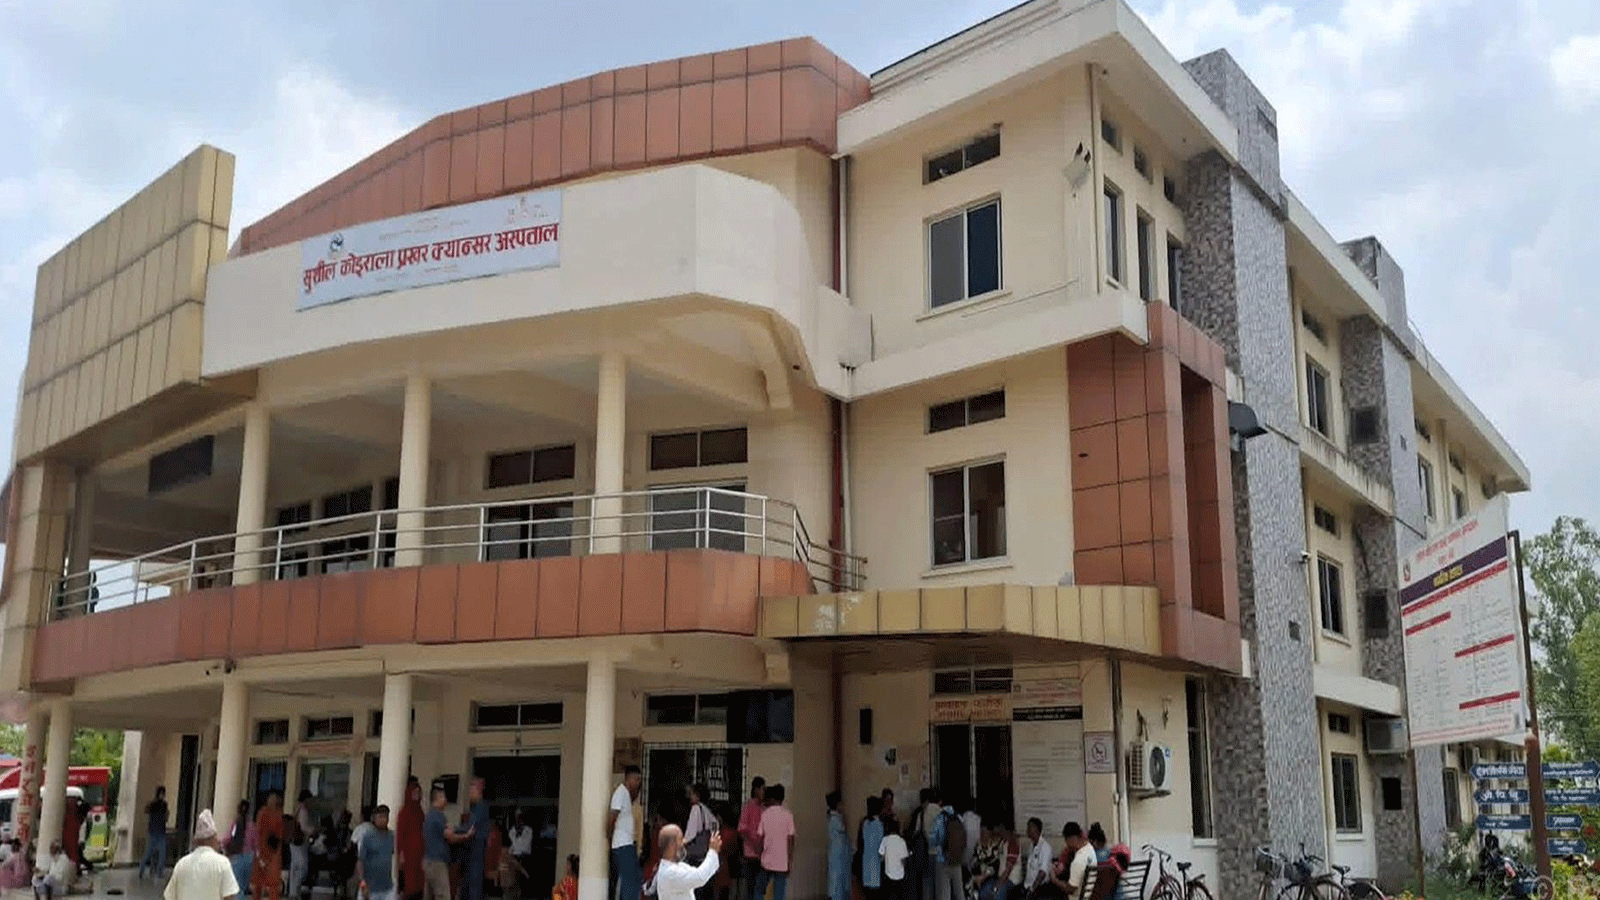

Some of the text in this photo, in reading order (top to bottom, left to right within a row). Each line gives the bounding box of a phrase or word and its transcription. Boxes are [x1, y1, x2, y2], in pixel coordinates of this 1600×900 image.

[303, 260, 338, 294] सुशील
[340, 252, 396, 278] कोइराला
[397, 243, 429, 270] प्रखर
[431, 233, 492, 261] क्यान्सर
[494, 222, 559, 252] अस्पताल
